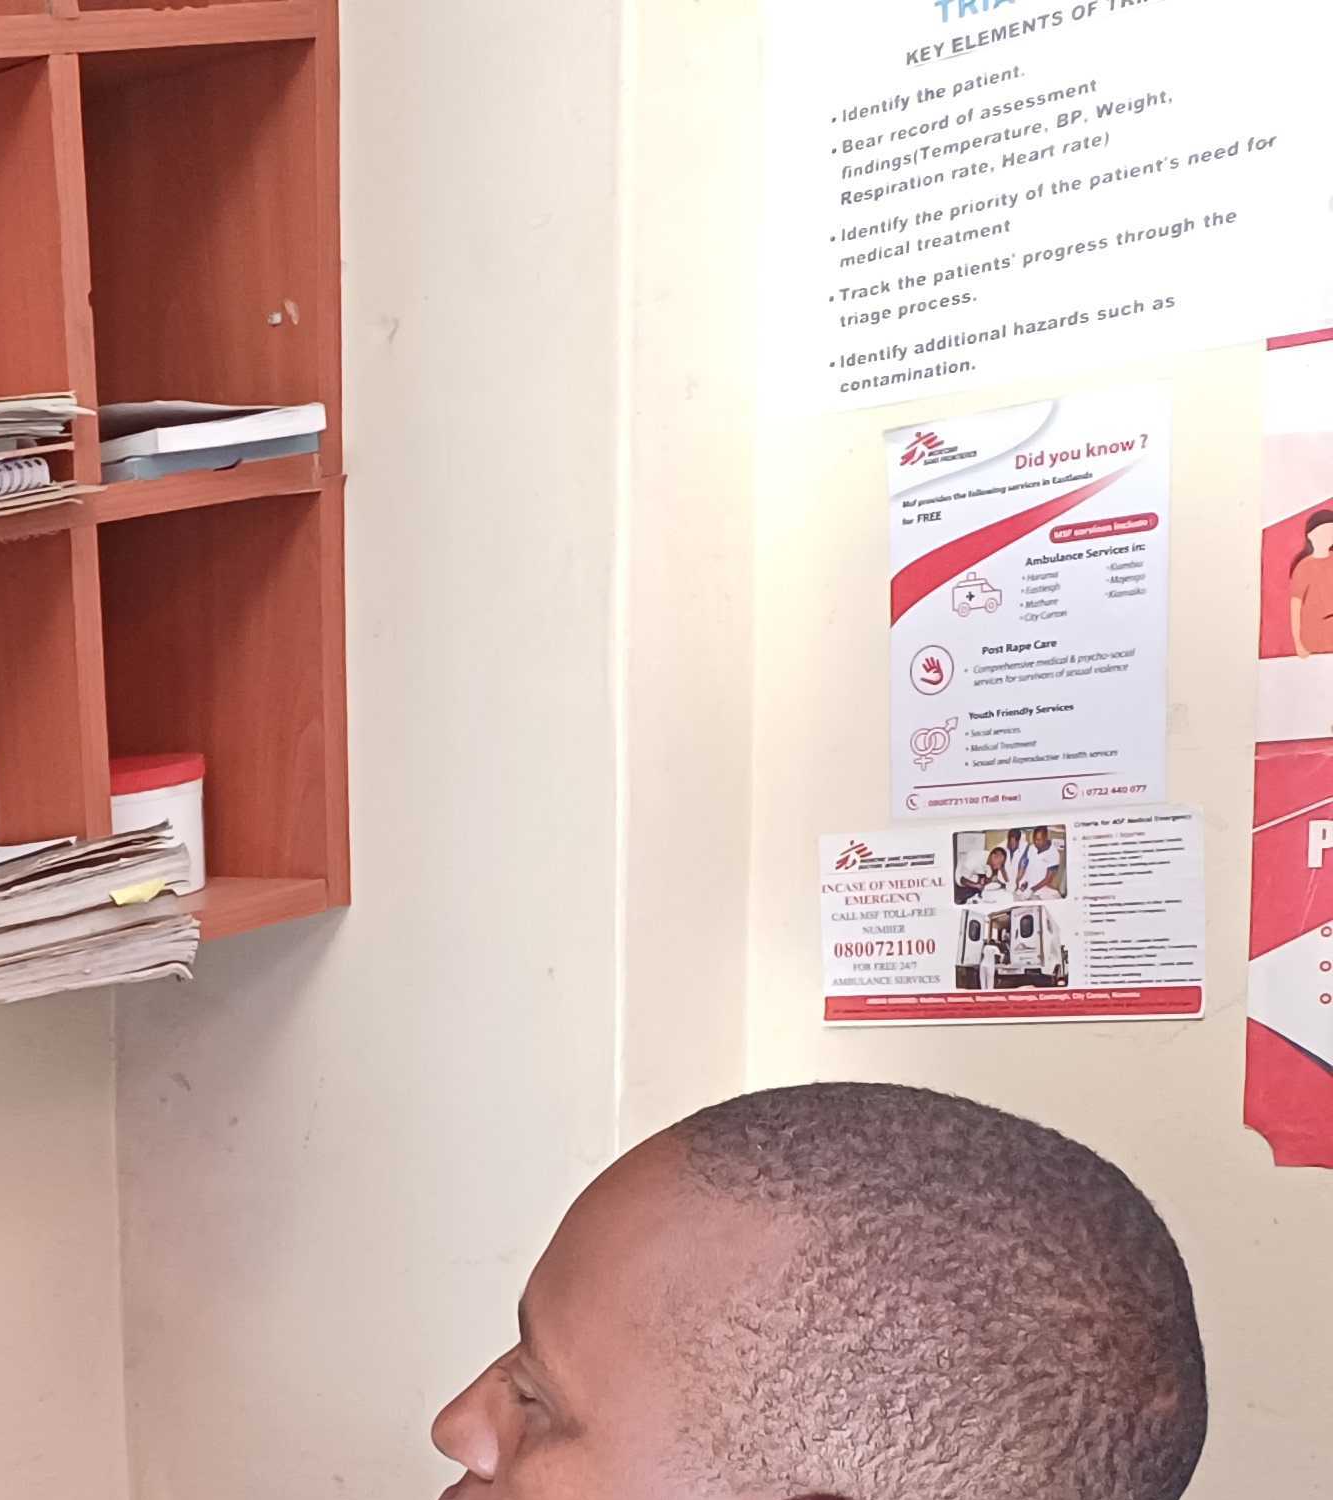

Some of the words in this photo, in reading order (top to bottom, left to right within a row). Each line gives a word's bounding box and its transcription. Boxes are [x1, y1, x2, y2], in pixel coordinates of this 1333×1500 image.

[906, 42, 944, 66] KEY
[952, 10, 1063, 54] ELEMENTS
[1071, 0, 1098, 21] OF
[843, 94, 910, 122] Identify
[917, 87, 946, 103] the
[953, 66, 1024, 98] patient.
[1096, 91, 1172, 119] Weight,
[842, 134, 883, 154] Bear
[890, 115, 949, 141] record
[956, 108, 973, 125] of
[980, 79, 1096, 120] assessment
[841, 173, 944, 206] Respiration
[952, 162, 994, 180] rate,
[1002, 145, 1055, 168] Heart
[1062, 131, 1109, 154] rate)
[841, 216, 908, 242] Identify
[916, 210, 943, 226] the
[950, 193, 1018, 221] priority
[1026, 183, 1043, 200] of
[1051, 179, 1082, 195] the
[1188, 141, 1239, 166] need
[1247, 136, 1277, 152] for
[839, 280, 890, 301] Track
[898, 275, 926, 290] the
[1023, 238, 1108, 268] progress
[1116, 218, 1194, 246] through
[1204, 212, 1237, 228] the
[840, 240, 909, 268] medical
[917, 220, 1010, 251] treatment
[840, 308, 891, 328] triage
[898, 292, 977, 319] process.
[841, 344, 907, 368] Identify
[914, 324, 1006, 355] additional
[1014, 311, 1089, 336] hazards
[1097, 300, 1144, 321] such
[1152, 297, 1175, 311] as
[840, 361, 975, 393] contamination.
[1015, 450, 1045, 470] Did
[1049, 449, 1081, 468] you
[1086, 439, 1135, 458] know
[1140, 433, 1148, 449] ?
[1025, 552, 1084, 566] Ambulance
[1086, 546, 1129, 559] Services
[1132, 543, 1145, 552] in:
[982, 645, 1003, 655] Post
[1006, 643, 1032, 653] Rape
[1034, 640, 1057, 649] Care
[968, 710, 994, 720] Youth
[996, 707, 1034, 717] Friendly
[1036, 704, 1074, 714] Services
[822, 882, 867, 894] INCASE
[870, 881, 883, 891] OF
[885, 877, 946, 890] MEDICAL
[845, 892, 920, 906] EMERGENCY
[834, 939, 935, 958] 0800721100
